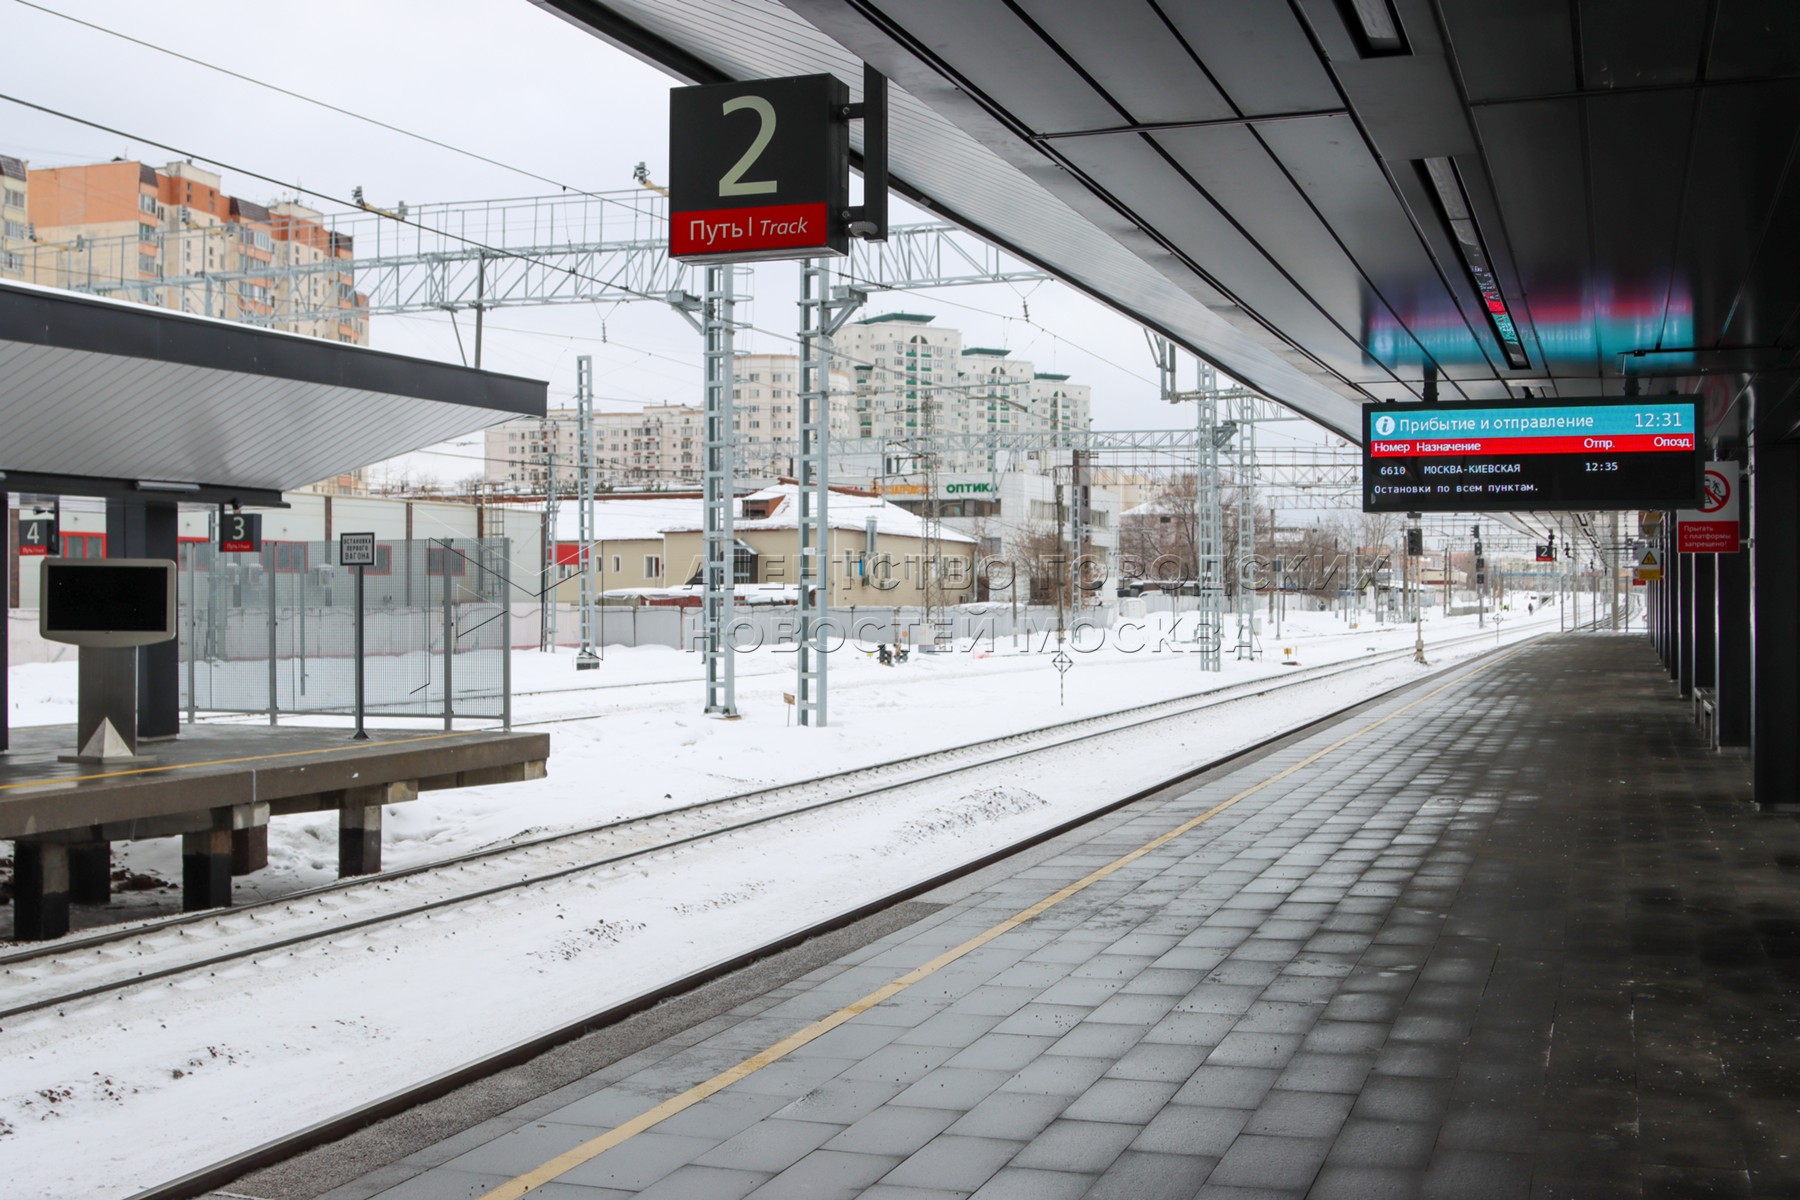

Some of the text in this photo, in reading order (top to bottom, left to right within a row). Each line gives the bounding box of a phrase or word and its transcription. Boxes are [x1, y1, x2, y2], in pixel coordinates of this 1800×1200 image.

[719, 95, 777, 197] 2
[690, 217, 808, 246] Путь Track
[1400, 416, 1594, 434] Прибытие и отправление
[1634, 412, 1682, 428] 12:31
[1374, 436, 1693, 453] Номер Назначение Отпр. Опозд.
[1380, 461, 1619, 475] 6610 МОСКВА-КИЕВСКАЯ 12:35
[946, 482, 998, 494] ОПТИКА
[1374, 484, 1539, 494] Остановки по всем пунктам.
[27, 521, 40, 544] 4
[232, 516, 245, 540] 3
[345, 552, 370, 560] ВАГОНА
[1540, 546, 1548, 557] 2
